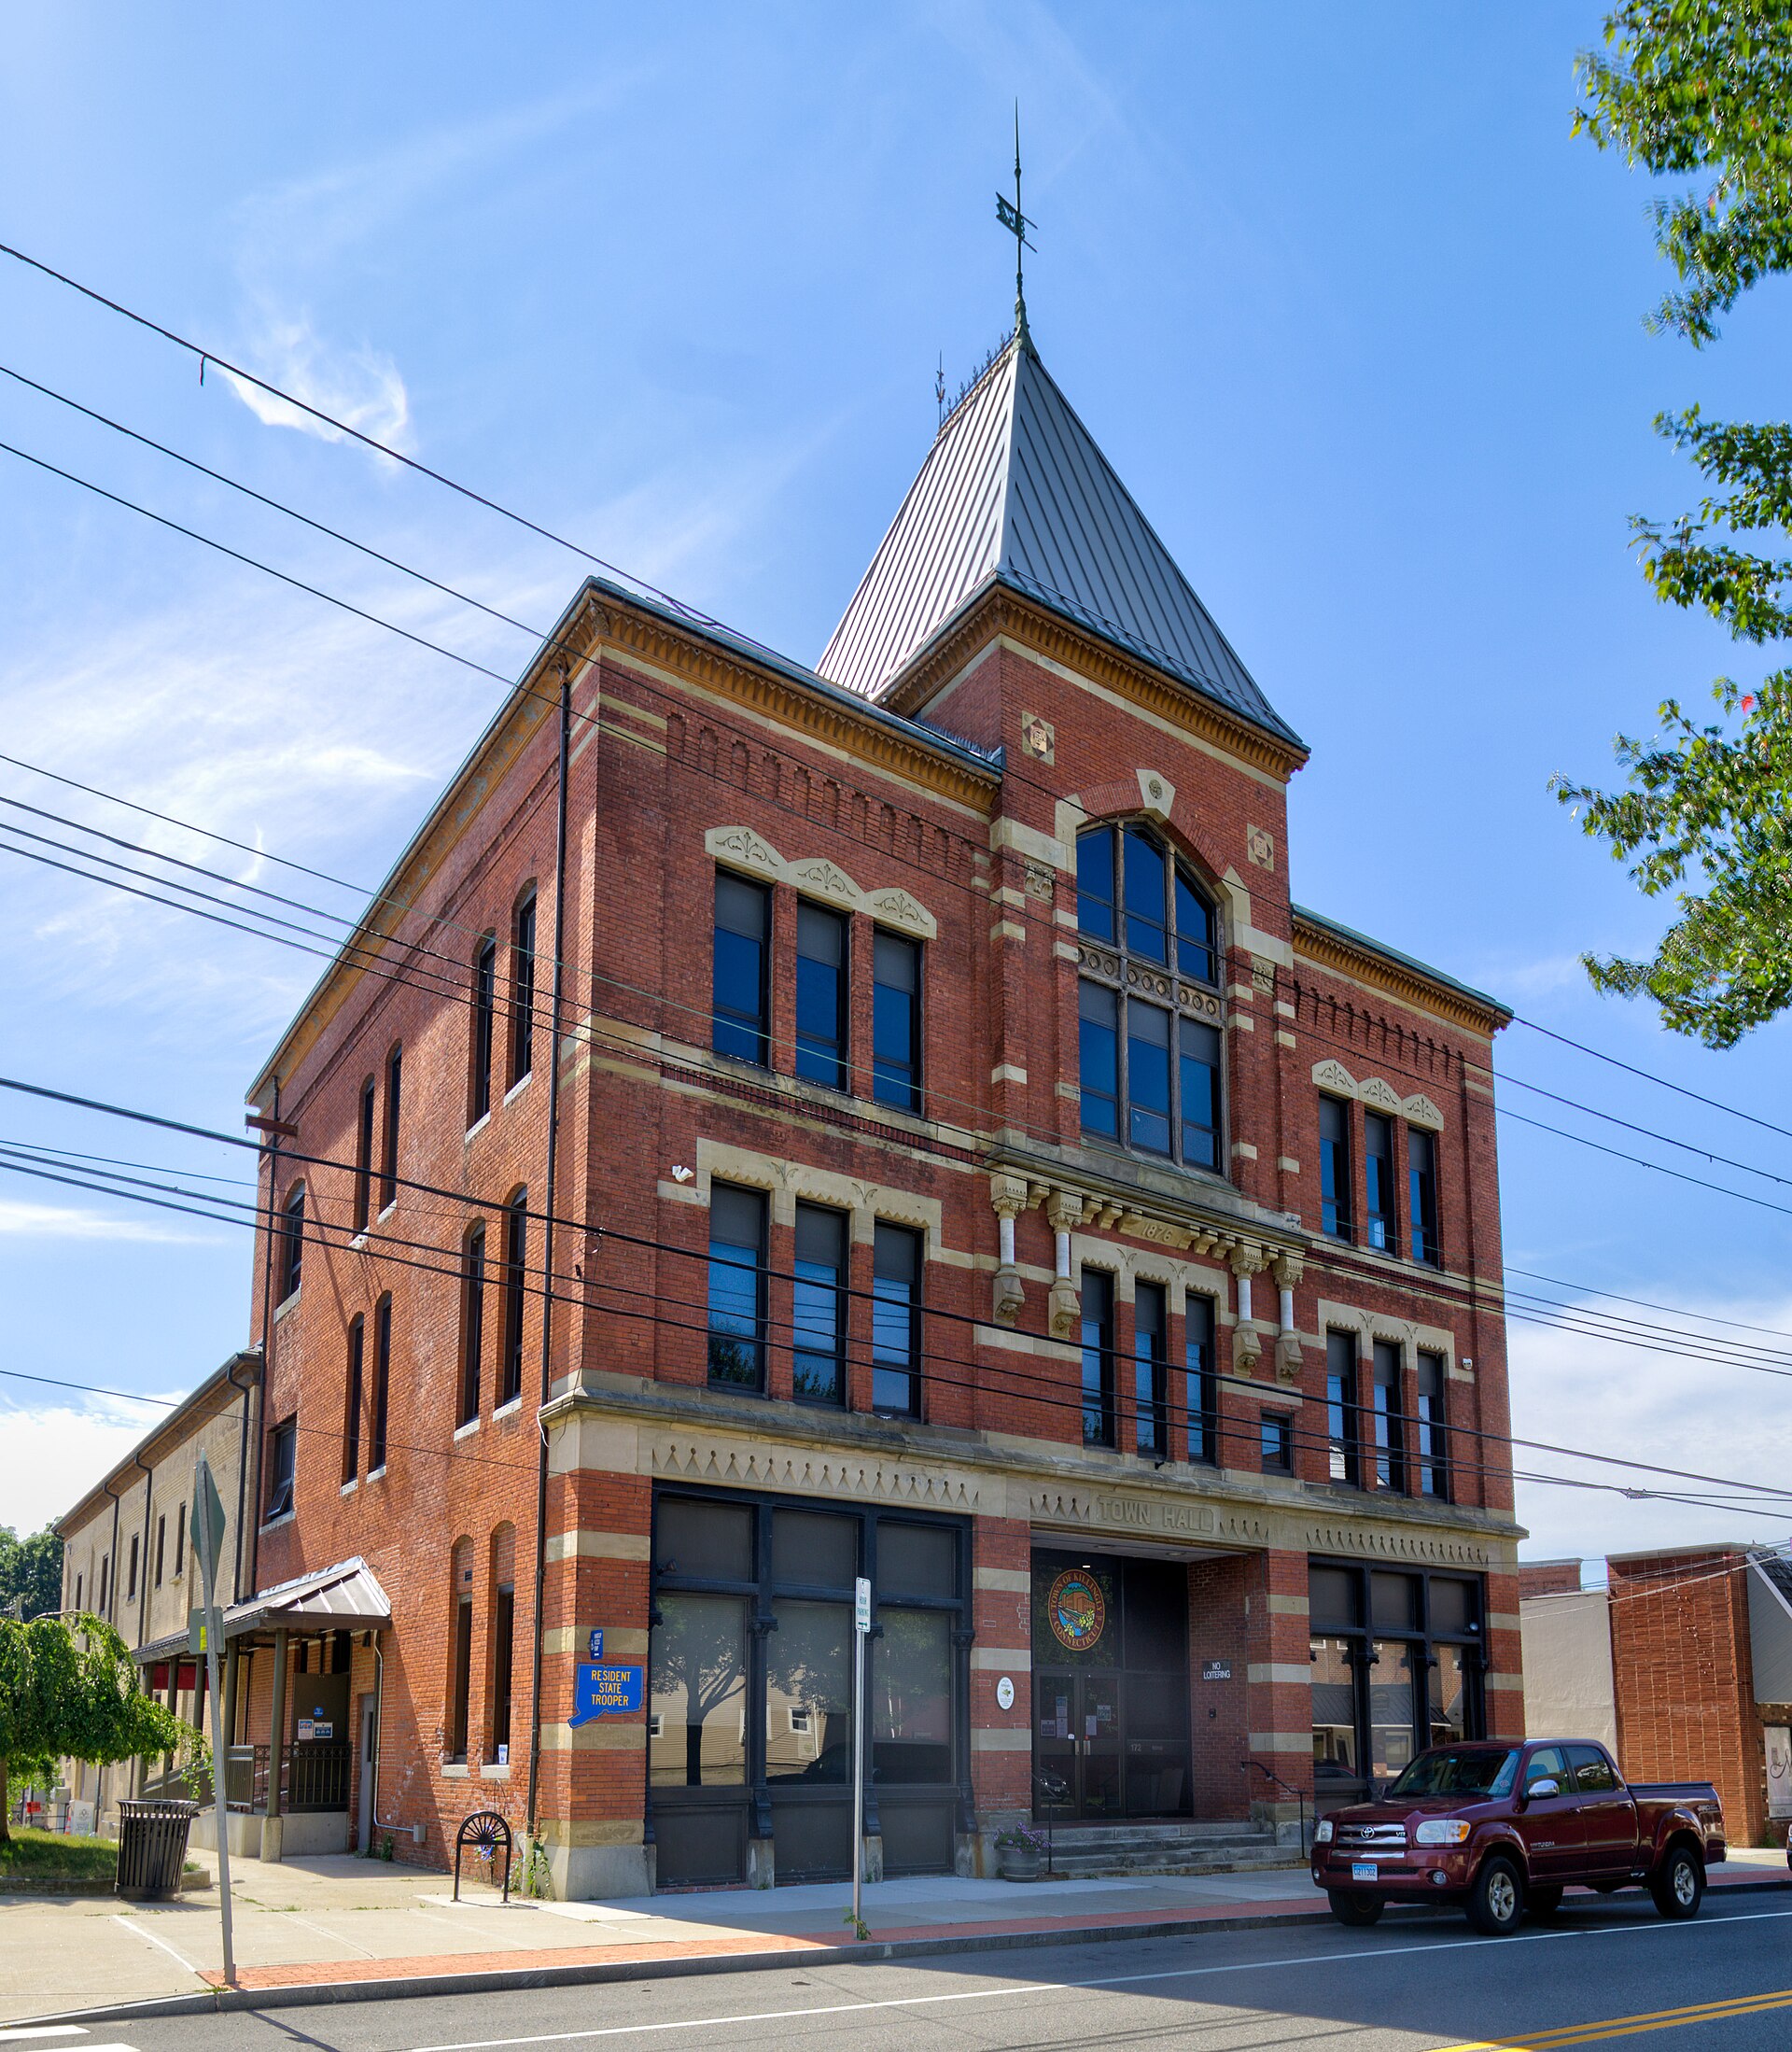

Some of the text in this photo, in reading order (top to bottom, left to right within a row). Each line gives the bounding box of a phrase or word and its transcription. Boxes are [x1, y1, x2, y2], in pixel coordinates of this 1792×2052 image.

[1141, 1223, 1173, 1242] 1876
[1099, 1499, 1212, 1532] TOWN HALL
[1051, 1572, 1102, 1611] TOWN OF KILLINGLY
[1054, 1622, 1100, 1647] CONNECTICUT
[1211, 1662, 1221, 1670] NO
[591, 1669, 631, 1682] RESIDENT
[1203, 1670, 1231, 1680] LOITERING
[598, 1682, 623, 1694] STATE
[591, 1694, 629, 1707] TROOPER
